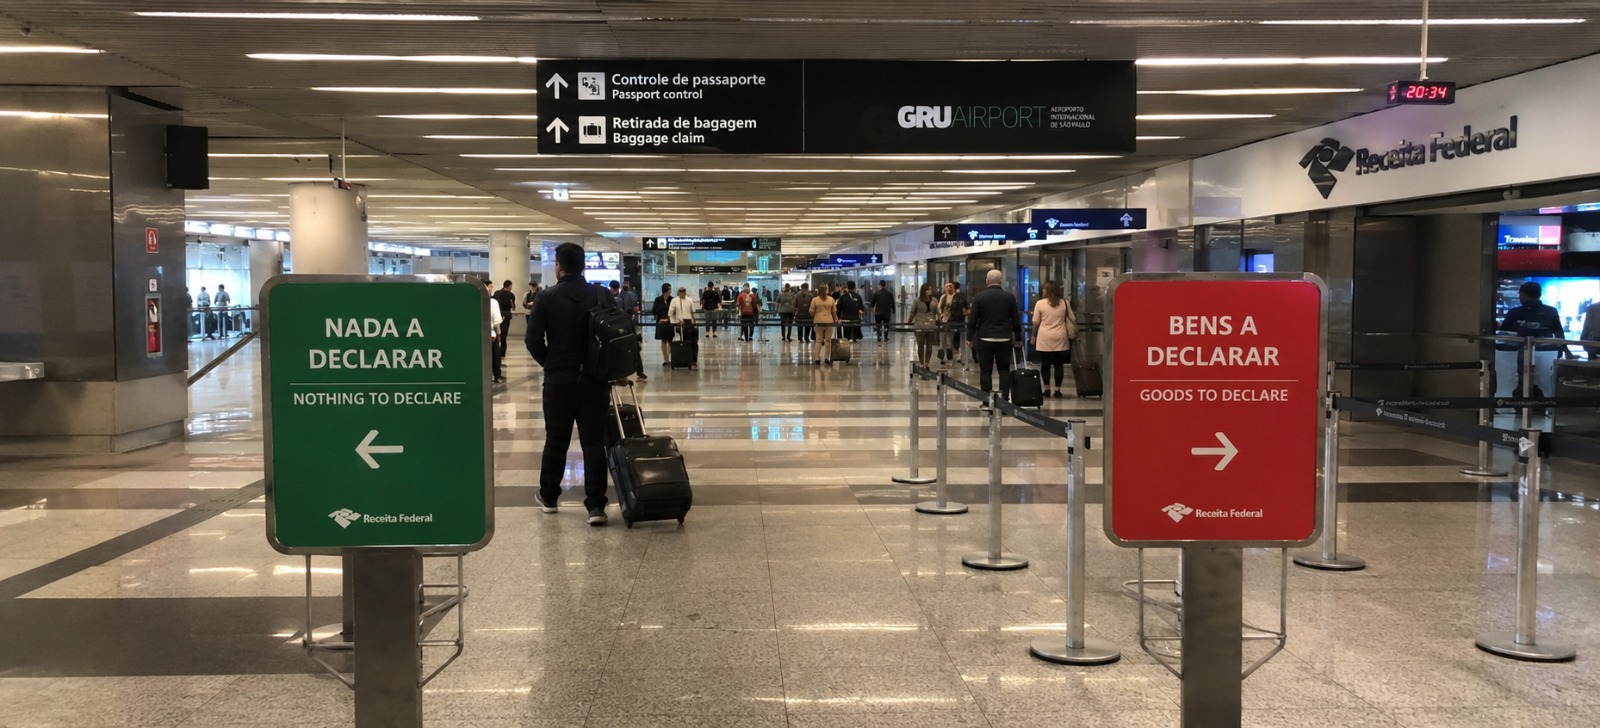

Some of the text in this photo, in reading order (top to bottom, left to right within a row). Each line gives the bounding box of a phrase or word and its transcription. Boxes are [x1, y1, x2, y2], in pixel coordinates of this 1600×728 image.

[611, 73, 766, 91] Controle de passaporte
[612, 88, 703, 102] Passport control
[1405, 85, 1448, 99] 20:34
[612, 116, 757, 132] Retirada de bagagem
[613, 131, 705, 147] Baggage claim
[1356, 115, 1518, 175] Receita Federal
[325, 317, 424, 338] NADA A
[1169, 315, 1258, 336] BENS A
[309, 348, 444, 369] DECLARAR
[1147, 346, 1280, 366] DECLARAR
[293, 391, 462, 405] NOTHING TO DECLARE
[1139, 389, 1289, 402] GOODS TO DECLARE
[363, 513, 433, 524] Receita Federal
[1195, 508, 1263, 519] Receita Federal
